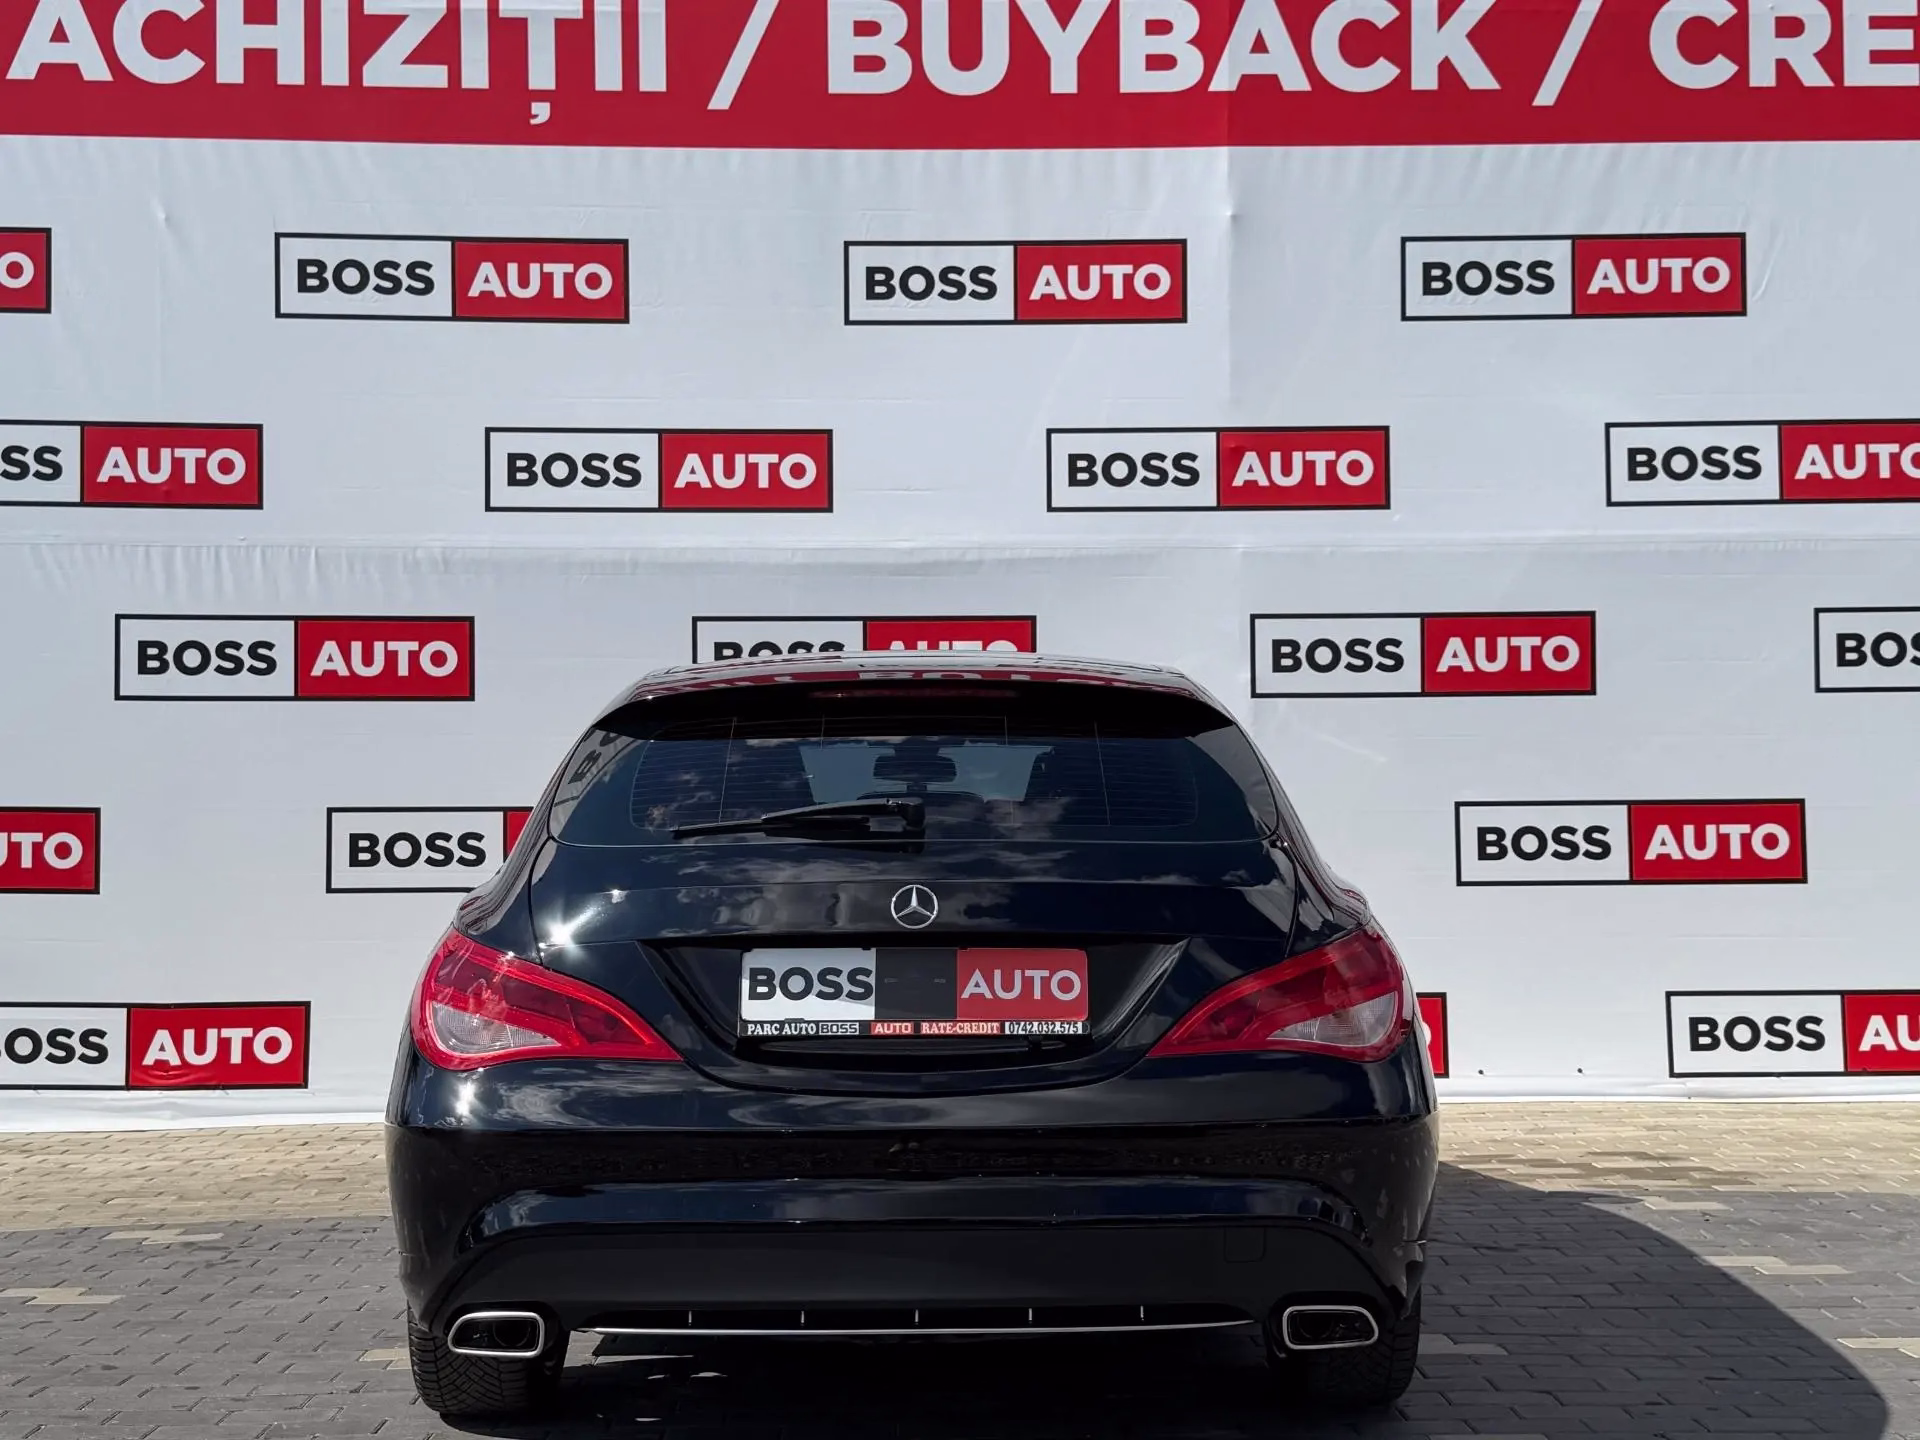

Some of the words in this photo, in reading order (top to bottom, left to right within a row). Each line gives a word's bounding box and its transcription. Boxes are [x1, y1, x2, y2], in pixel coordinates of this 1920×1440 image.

[6, 0, 666, 124] ACHIZIȚII
[828, 0, 1500, 95] BUYBACK
[1650, 0, 1920, 89] CRE
[298, 259, 434, 295] BOSS
[468, 262, 612, 299] AUTO
[866, 266, 997, 300] BOSS
[1030, 264, 1170, 300] AUTO
[1423, 260, 1554, 296] BOSS
[1587, 257, 1730, 294] AUTO
[97, 447, 245, 484] AUTO
[508, 453, 641, 487] BOSS
[674, 454, 816, 488] AUTO
[1068, 452, 1199, 487] BOSS
[1232, 451, 1373, 486] AUTO
[1628, 446, 1761, 481] BOSS
[1795, 443, 1920, 479] AUTO
[138, 640, 277, 676] BOSS
[311, 641, 457, 676] AUTO
[1272, 638, 1404, 673] BOSS
[1437, 636, 1579, 672] AUTO
[0, 832, 82, 868] TO
[349, 832, 486, 867] BOSS
[1478, 826, 1611, 860] BOSS
[1645, 824, 1789, 860] AUTO
[749, 967, 873, 1000] BOSS
[961, 969, 1080, 1000] AUTO
[0, 1028, 108, 1064] OSS
[143, 1027, 292, 1065] AUTO
[747, 1023, 780, 1035] PARC
[782, 1023, 817, 1035] AUTO
[820, 1023, 859, 1034] BOSS
[874, 1022, 912, 1034] AUTO
[921, 1022, 1000, 1034] RATE-CREDIT
[1008, 1022, 1079, 1034] 0742.032.575
[1689, 1016, 1825, 1051] BOSS
